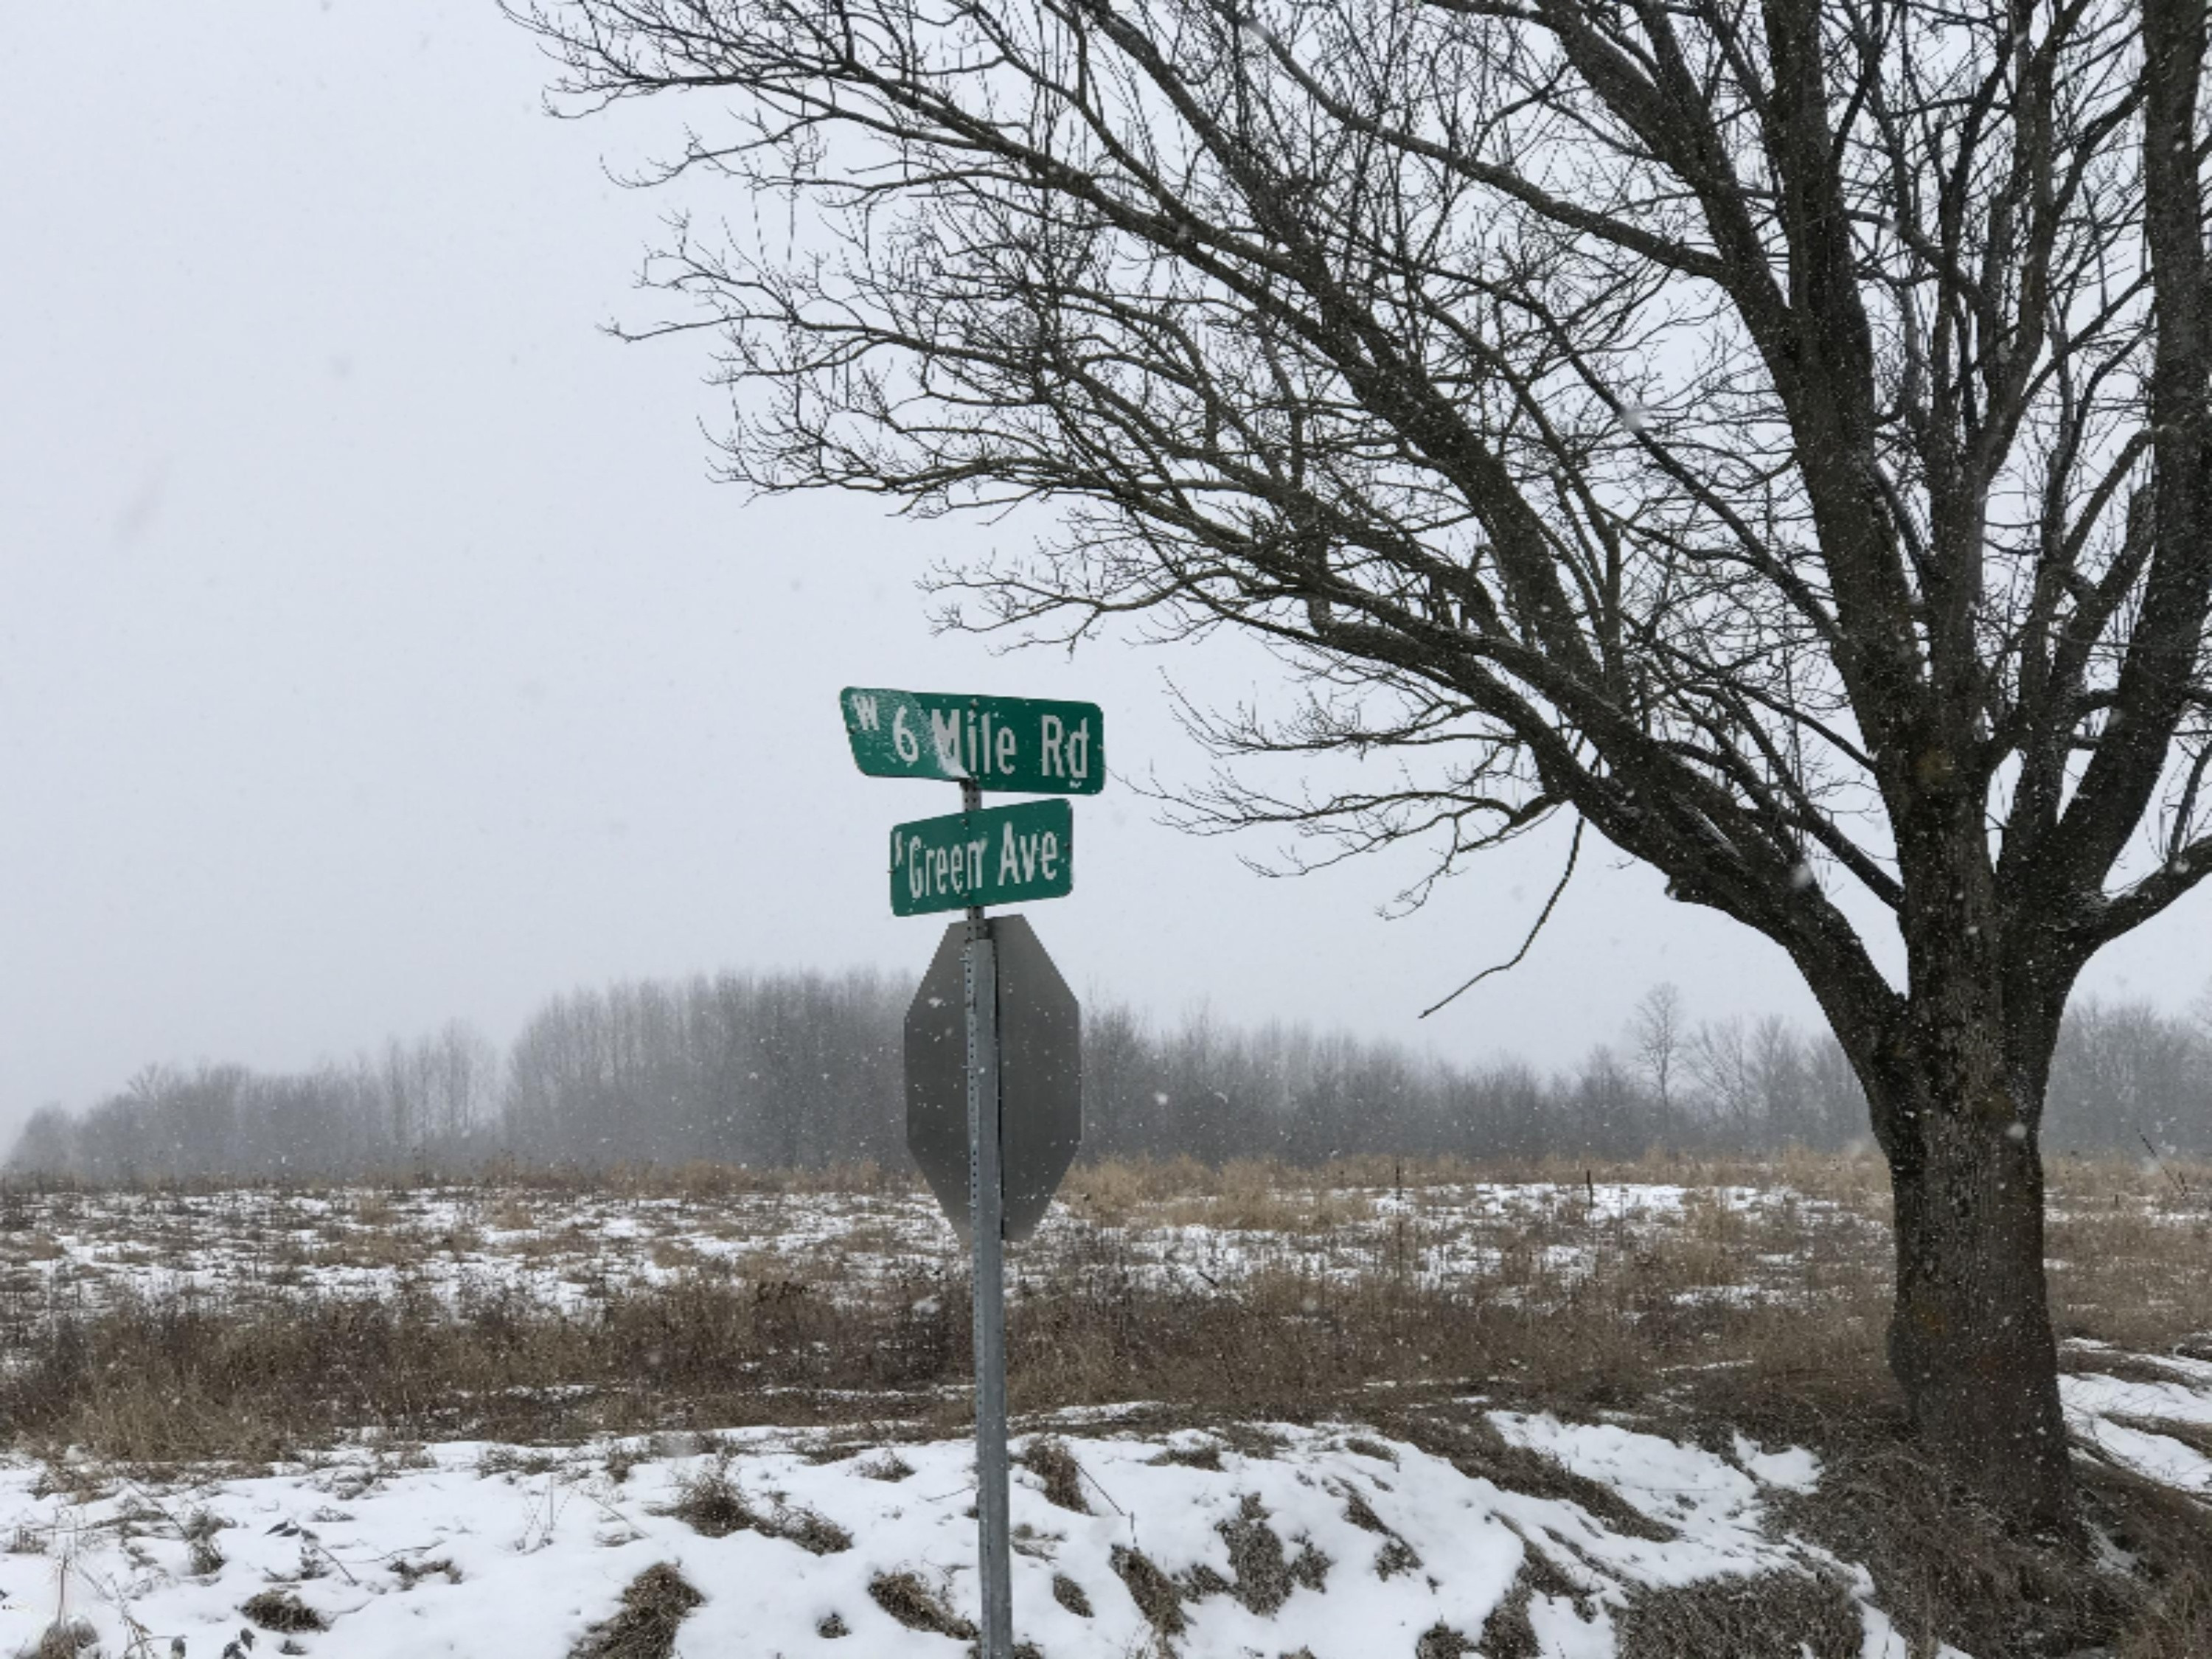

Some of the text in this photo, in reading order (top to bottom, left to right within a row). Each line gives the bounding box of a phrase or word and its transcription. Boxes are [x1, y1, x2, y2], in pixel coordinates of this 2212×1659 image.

[892, 705, 919, 762] 6
[931, 709, 1017, 775] Mile
[1041, 714, 1089, 779] Rd
[908, 835, 983, 899] Green
[998, 821, 1058, 886] Ave
